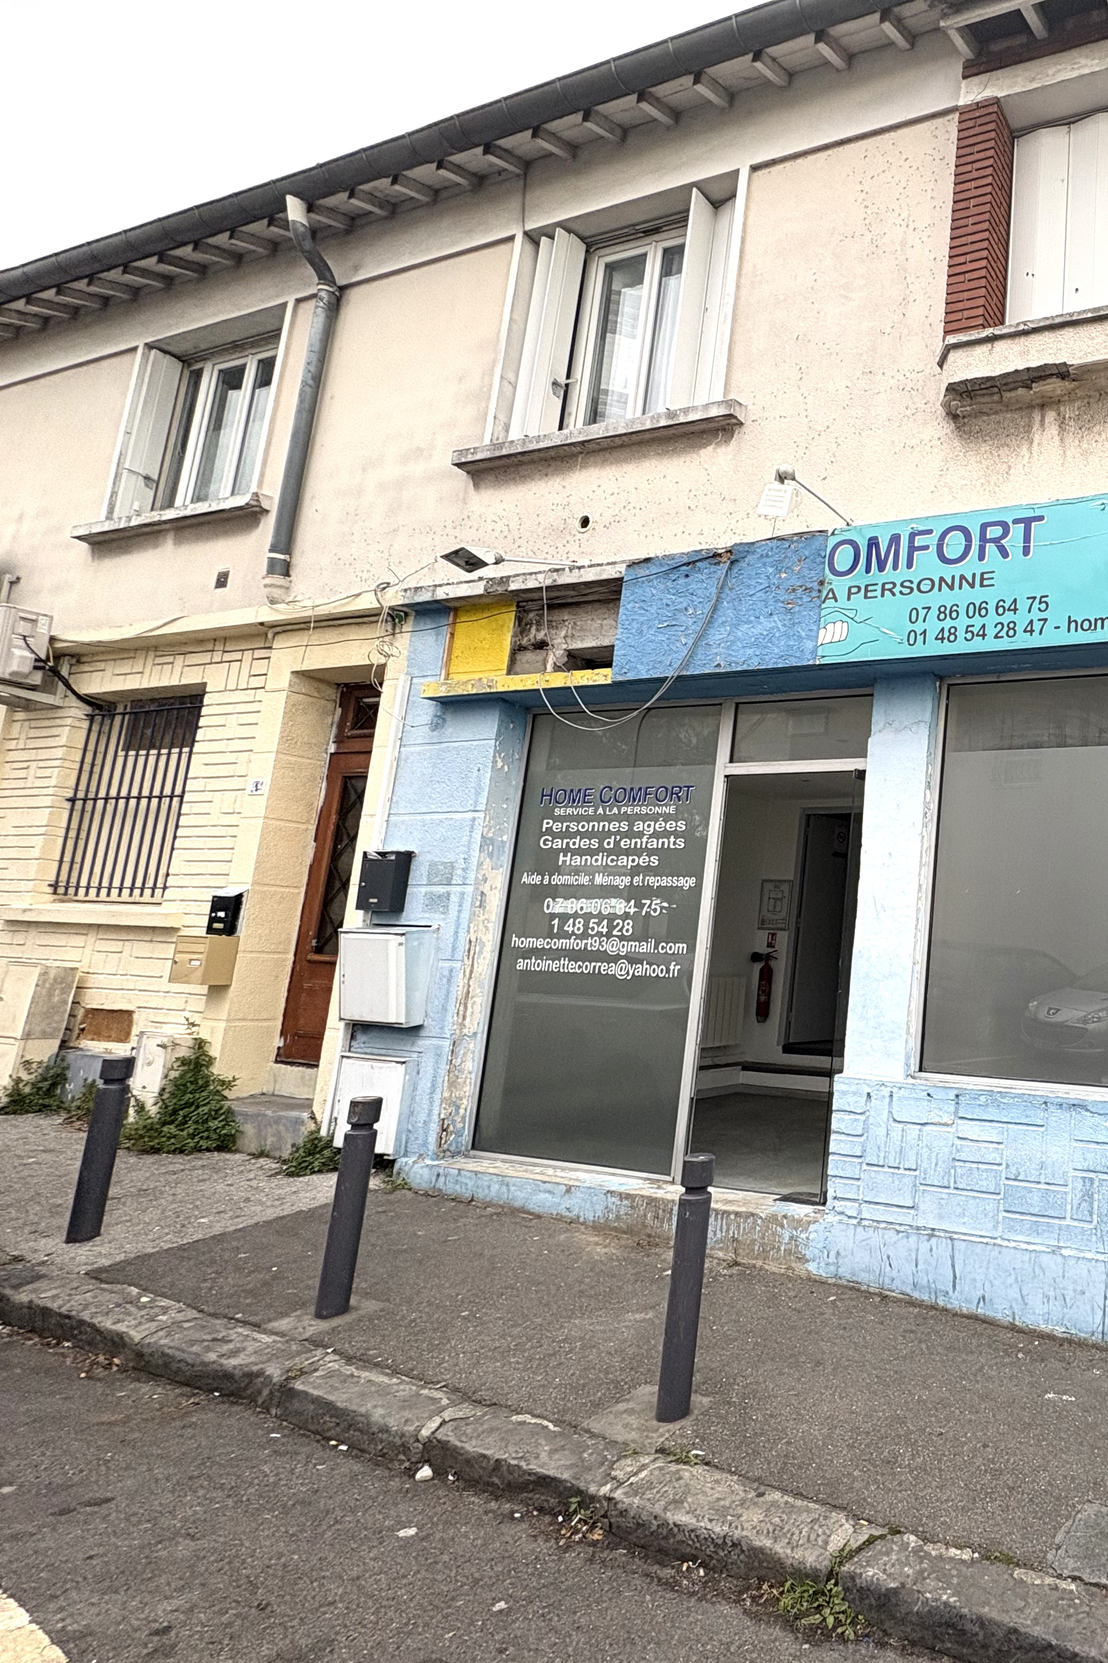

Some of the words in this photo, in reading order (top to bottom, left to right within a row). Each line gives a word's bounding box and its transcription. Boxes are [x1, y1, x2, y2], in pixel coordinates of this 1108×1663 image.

[846, 570, 996, 602] PERSONNE
[908, 606, 932, 624] 07
[936, 603, 960, 622] 86
[965, 601, 989, 619] 06
[994, 597, 1019, 617] 64
[1026, 594, 1050, 614] 75
[906, 628, 928, 647] 01
[934, 625, 958, 644] 48
[963, 623, 988, 642] 54
[993, 620, 1017, 639] 28
[1022, 617, 1049, 637] 47
[539, 787, 596, 807] HOME
[599, 785, 696, 806] COMFORT
[553, 807, 595, 816] SERVICE
[605, 806, 619, 815] LA
[620, 805, 677, 815] PERSONNE
[542, 819, 629, 832] Personnes
[633, 817, 687, 835] agées
[539, 835, 599, 849] Gardes
[603, 835, 685, 849] d’enfants
[558, 852, 659, 870] Handicapés
[521, 872, 542, 885] Aide
[543, 872, 550, 885] à
[550, 871, 593, 886] domicile:
[594, 872, 632, 890] Ménage
[632, 873, 643, 886] et
[644, 876, 696, 890] repassage
[543, 897, 565, 914] 07
[567, 897, 587, 915] 86
[591, 898, 611, 915] 06
[615, 899, 636, 916] 64
[551, 917, 559, 934] 1
[563, 918, 584, 935] 48
[588, 918, 609, 936] 54
[612, 919, 634, 936] 28
[511, 934, 688, 956] homecomfort93@gmail.com
